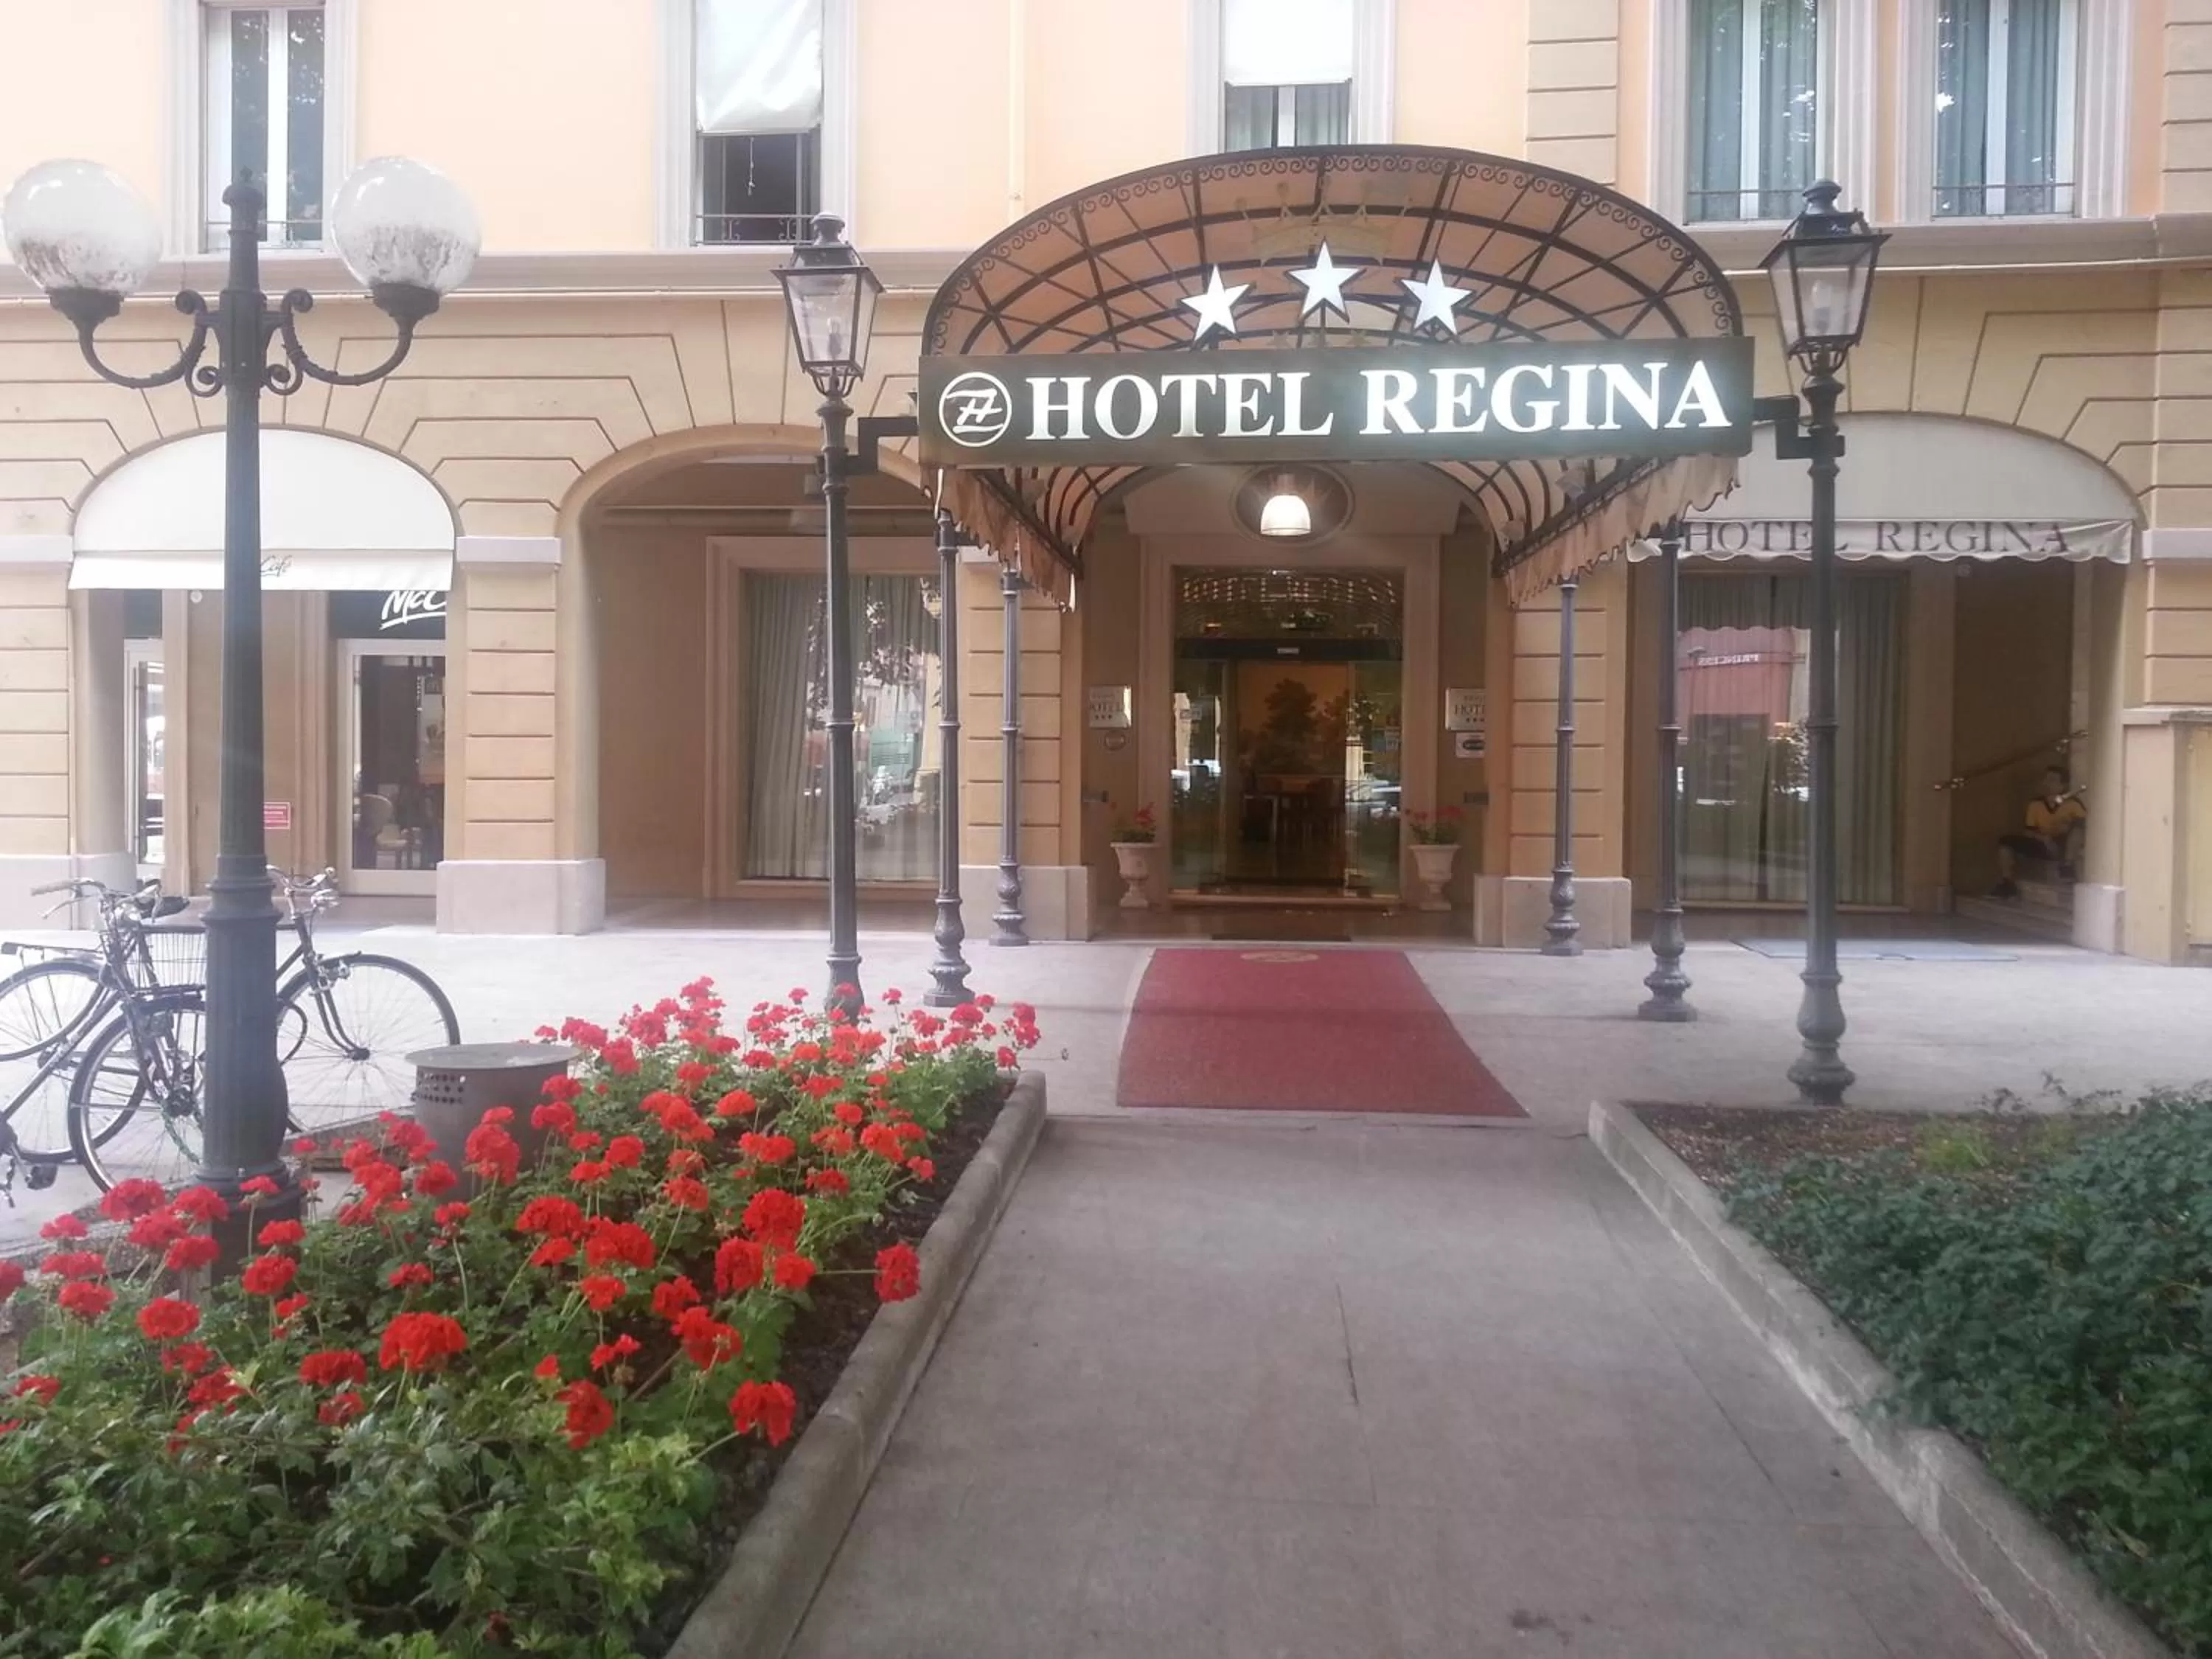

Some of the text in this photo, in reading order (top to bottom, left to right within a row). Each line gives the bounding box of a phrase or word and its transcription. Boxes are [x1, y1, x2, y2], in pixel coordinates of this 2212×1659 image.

[1025, 360, 1733, 441] HOTEL REGINA
[1685, 521, 2069, 552] HOTE REGINA
